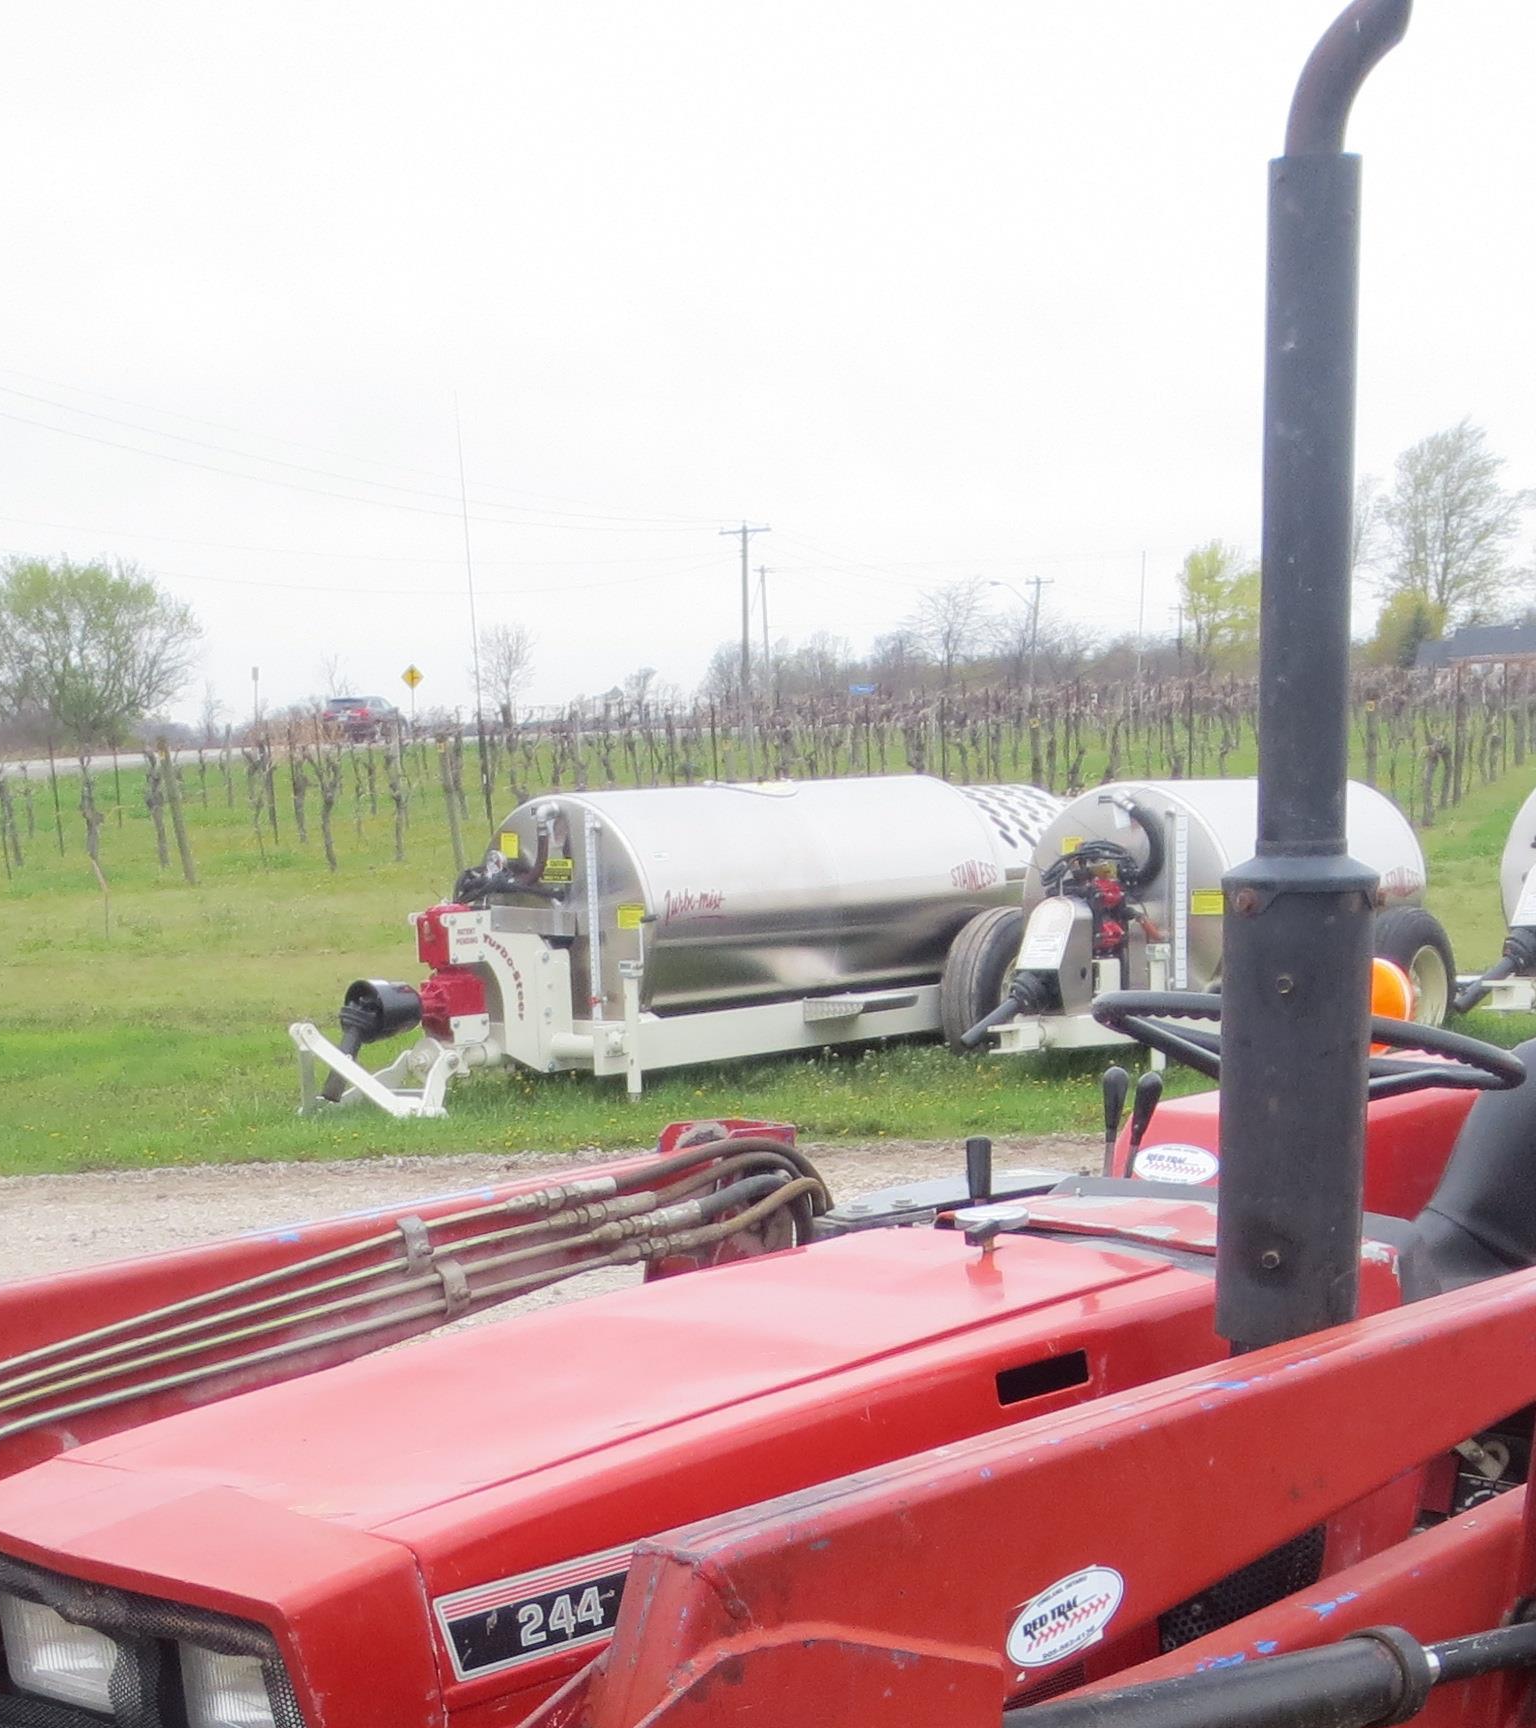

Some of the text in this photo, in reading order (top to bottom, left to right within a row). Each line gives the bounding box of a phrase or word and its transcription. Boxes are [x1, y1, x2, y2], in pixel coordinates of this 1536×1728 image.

[950, 860, 998, 893] STAINLESS
[518, 1586, 605, 1647] 244
[1023, 1595, 1079, 1640] RED TRAC
